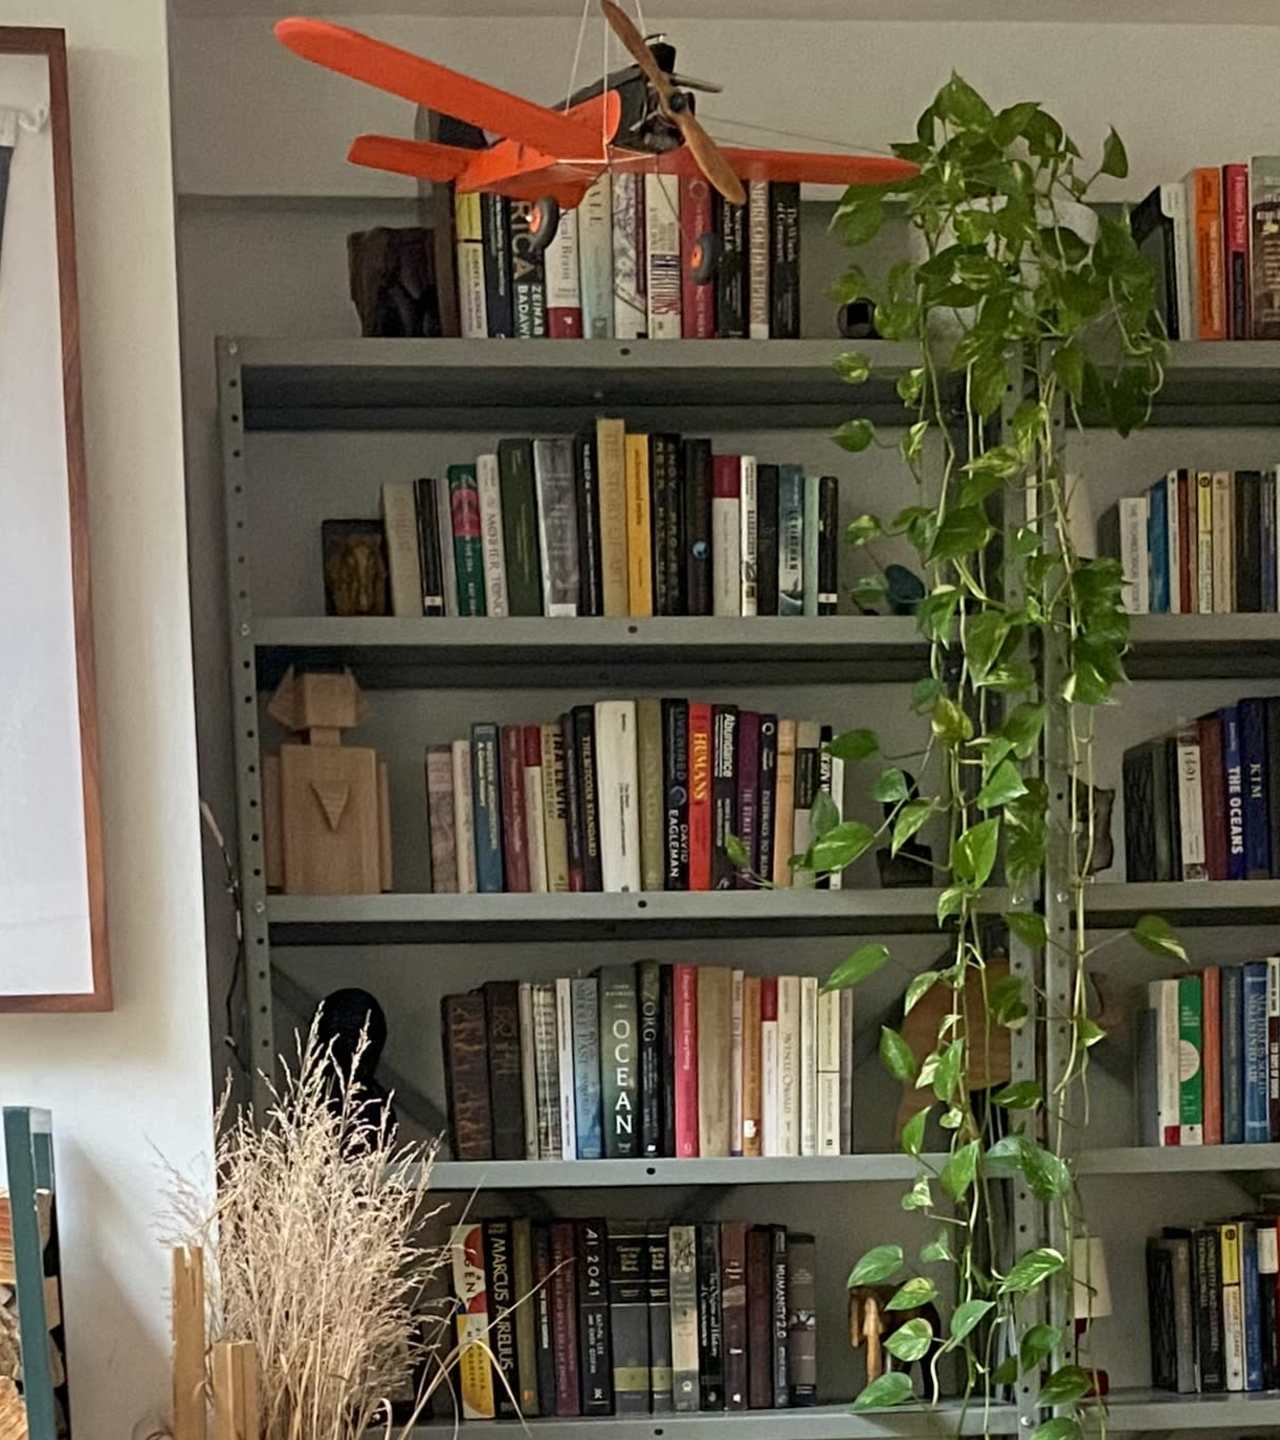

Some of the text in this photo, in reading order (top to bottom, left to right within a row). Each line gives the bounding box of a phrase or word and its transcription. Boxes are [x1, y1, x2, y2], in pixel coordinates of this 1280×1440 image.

[751, 227, 767, 247] OF
[775, 202, 785, 213] of
[787, 208, 797, 225] The
[531, 285, 544, 335] ZEINAB
[751, 249, 767, 324] DECEPTION
[604, 433, 618, 462] THE
[606, 469, 620, 523] STORY
[609, 556, 622, 586] ART
[668, 512, 679, 597] PROJECT
[788, 509, 800, 570] LEVIATHAN
[675, 705, 686, 780] LIVEWIRED
[693, 732, 708, 800] HUMANS
[722, 713, 736, 778] Abundance
[485, 742, 499, 849] MODERN ARCHITECTURE
[544, 758, 554, 799] PERFECT
[552, 732, 569, 820] IRA LEVIN
[582, 736, 597, 857] THE BITCOIN STANDARD
[1249, 763, 1262, 798] KIM
[1228, 765, 1244, 855] THE OCEANS
[668, 809, 680, 878] EAGLEMAN
[680, 823, 689, 863] DAVID
[643, 990, 657, 1042] ZORG
[612, 1020, 633, 1135] OCEAN
[681, 1029, 692, 1071] Everything
[585, 1228, 601, 1297] AI 2041
[490, 1238, 514, 1371] MARCUS AURELIUS
[776, 1264, 787, 1338] HUMANITY 2.0
